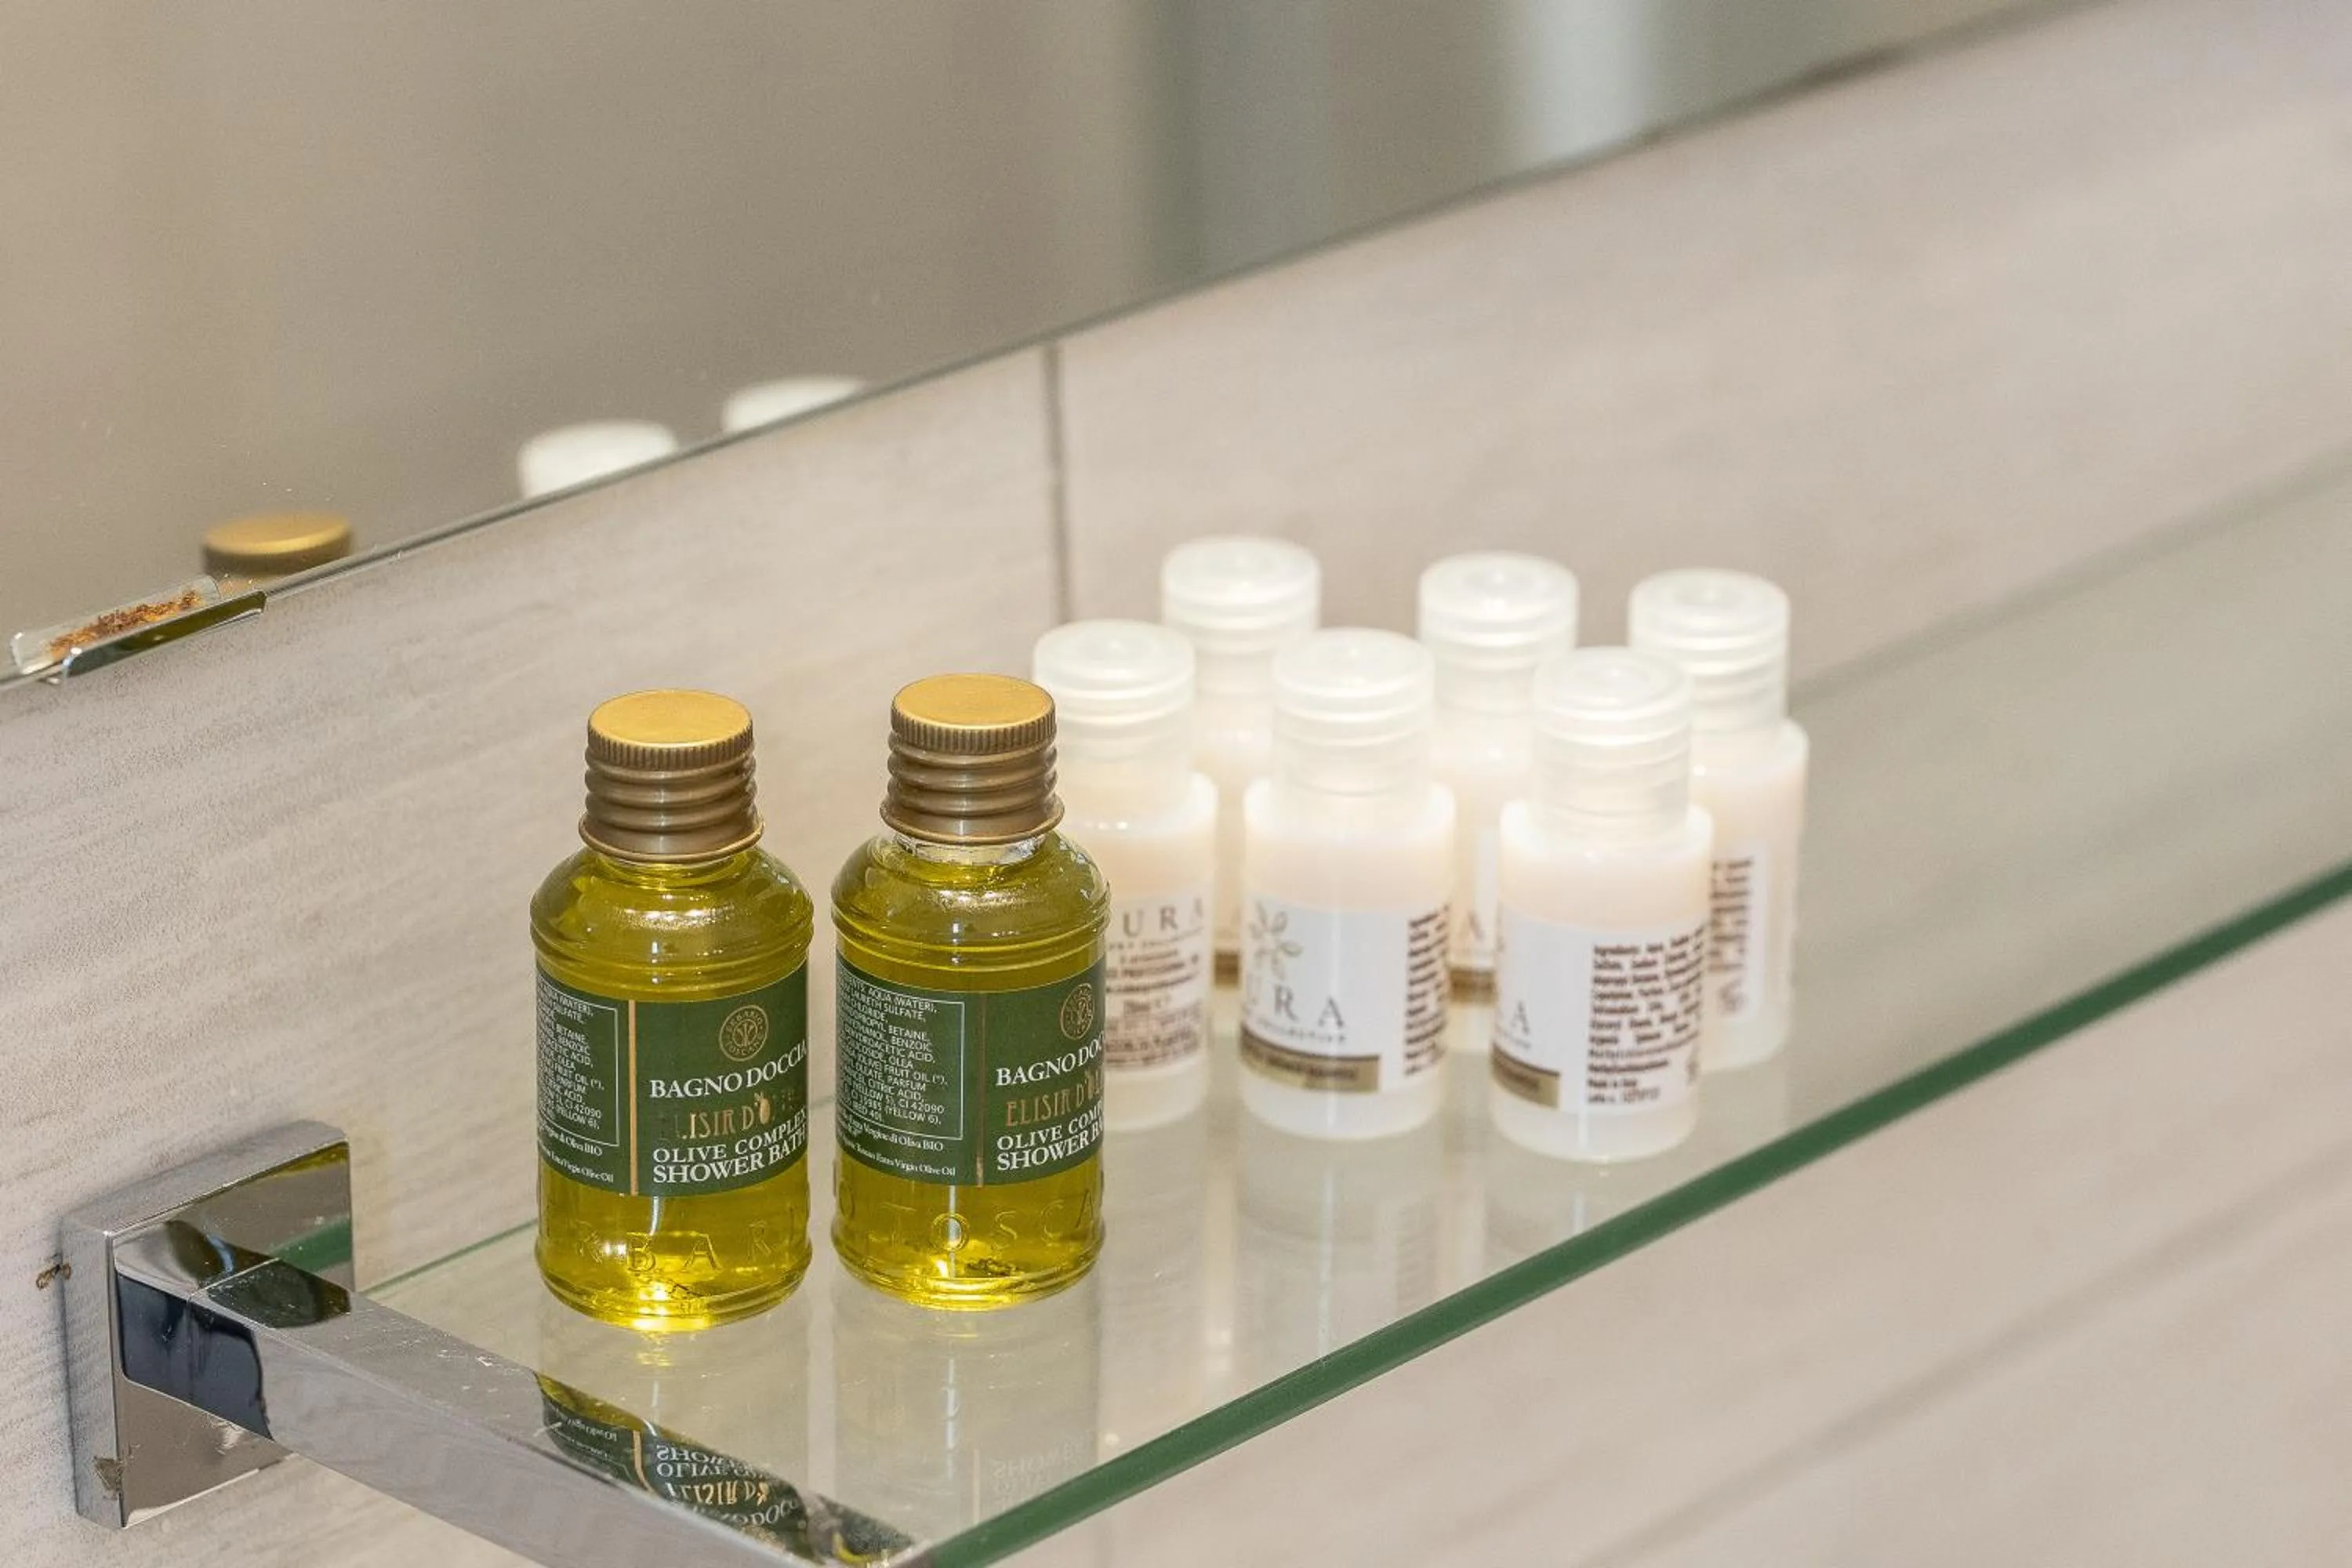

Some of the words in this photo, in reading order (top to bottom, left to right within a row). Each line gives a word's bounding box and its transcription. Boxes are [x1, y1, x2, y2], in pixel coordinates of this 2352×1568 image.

[996, 1053, 1076, 1086] BAGNO
[649, 1073, 742, 1098] BAGNO
[910, 1101, 945, 1114] 42090
[1006, 1088, 1072, 1127] ELISIR
[923, 1139, 943, 1152] BIO
[996, 1124, 1062, 1151] OLIVE
[996, 1130, 1090, 1171] SHOWER
[653, 1145, 727, 1163] OLIVE
[653, 1152, 765, 1183] SHOWER
